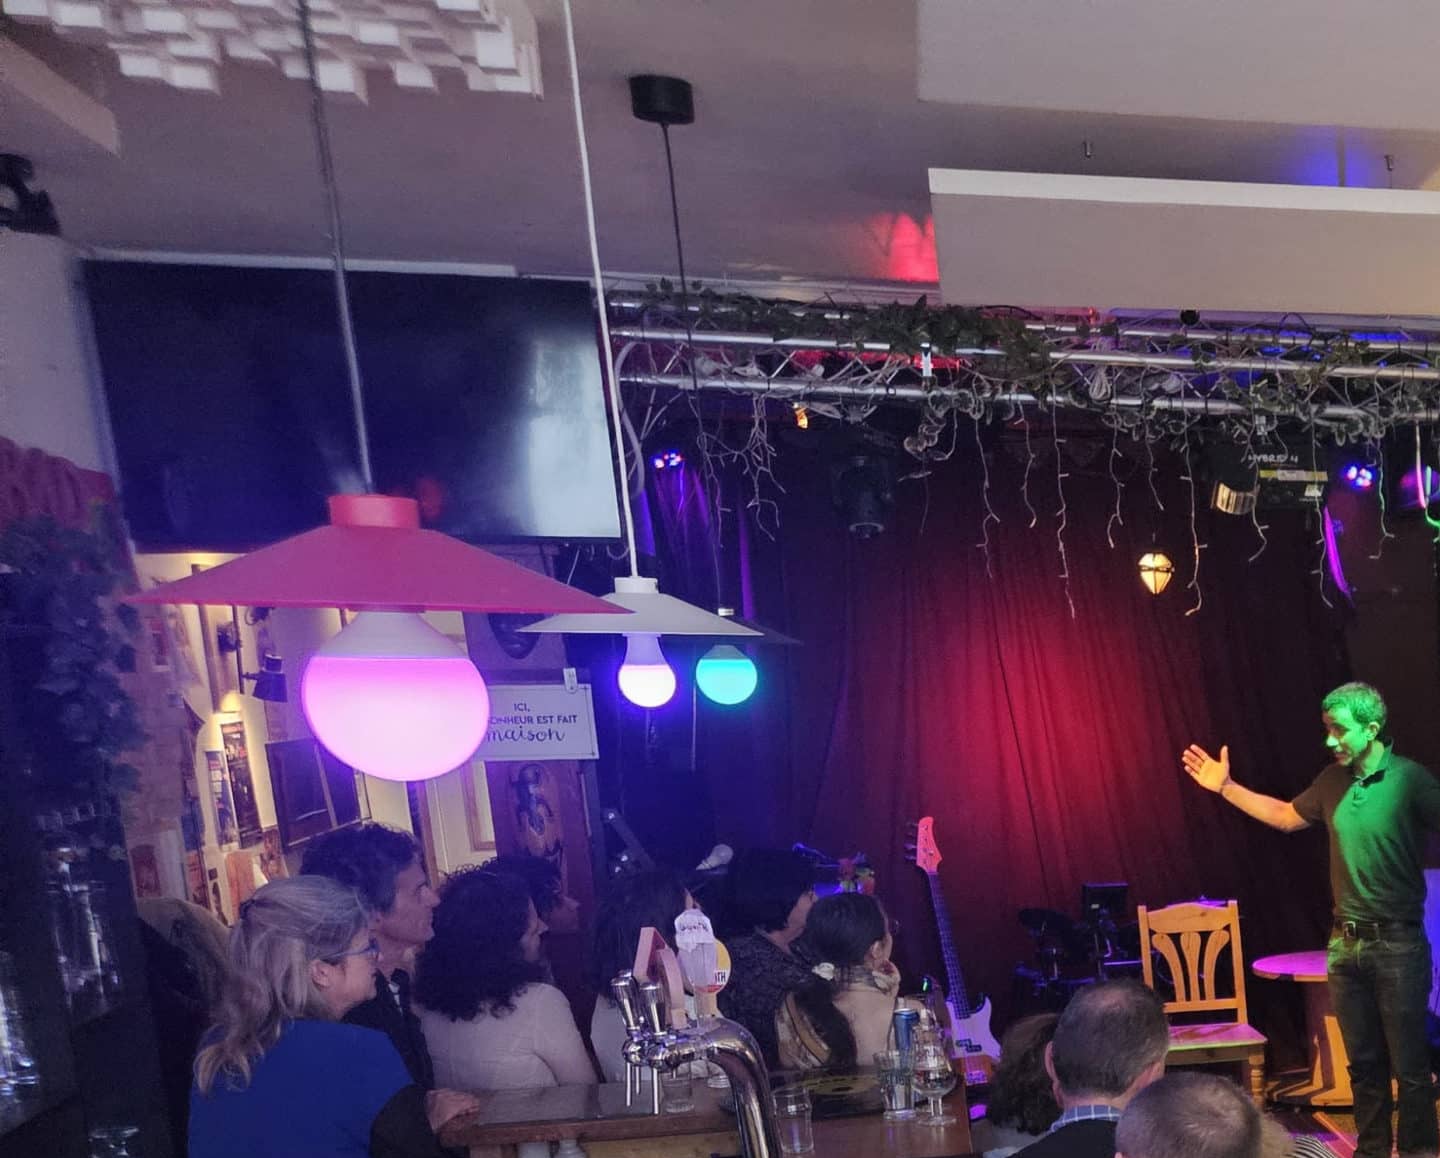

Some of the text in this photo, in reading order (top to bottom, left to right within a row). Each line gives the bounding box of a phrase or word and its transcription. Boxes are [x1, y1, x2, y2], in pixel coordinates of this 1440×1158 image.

[488, 714, 578, 725] ONHEUR EST FAIT
[486, 725, 566, 743] maison
